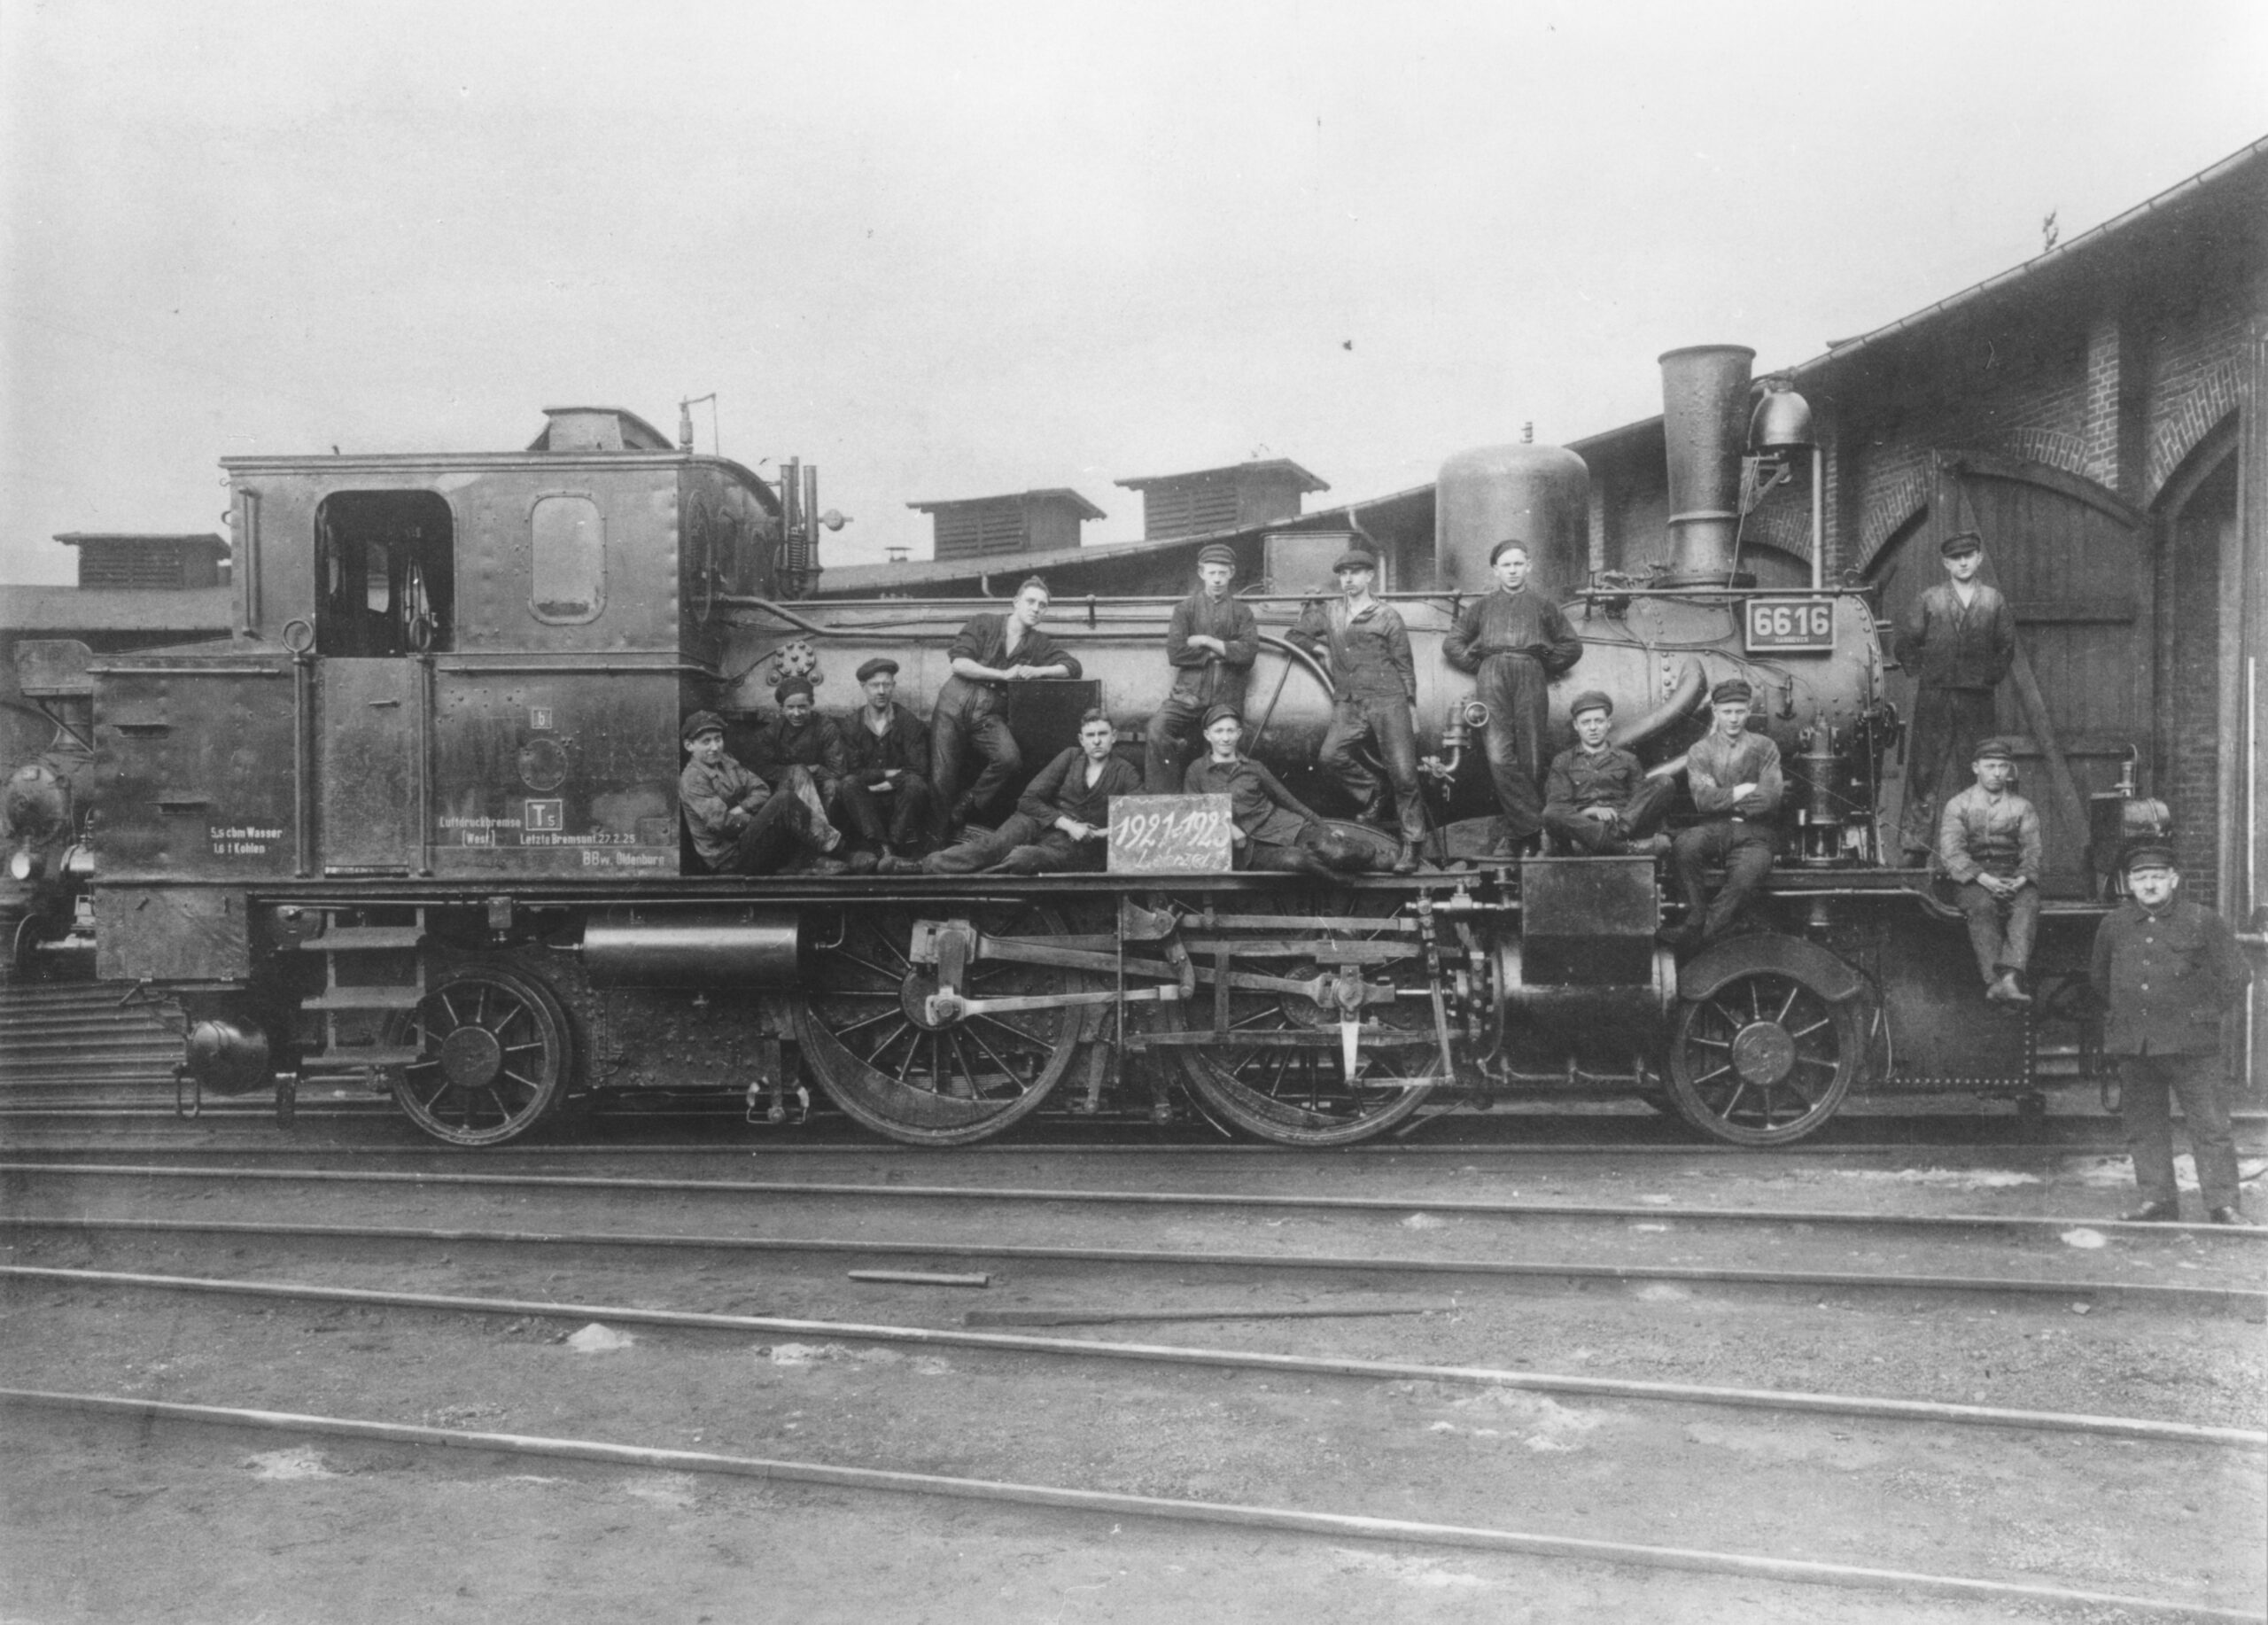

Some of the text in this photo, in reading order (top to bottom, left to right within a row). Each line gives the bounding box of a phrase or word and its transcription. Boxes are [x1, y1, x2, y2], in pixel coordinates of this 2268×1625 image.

[1754, 606, 1829, 636] 6616
[439, 816, 522, 828] Luftdruckbremse
[225, 826, 245, 839] cbm
[246, 826, 283, 839] Wasser
[519, 834, 550, 845] Letzte
[234, 842, 266, 855] Kohlen
[616, 851, 664, 867] Oldenburg
